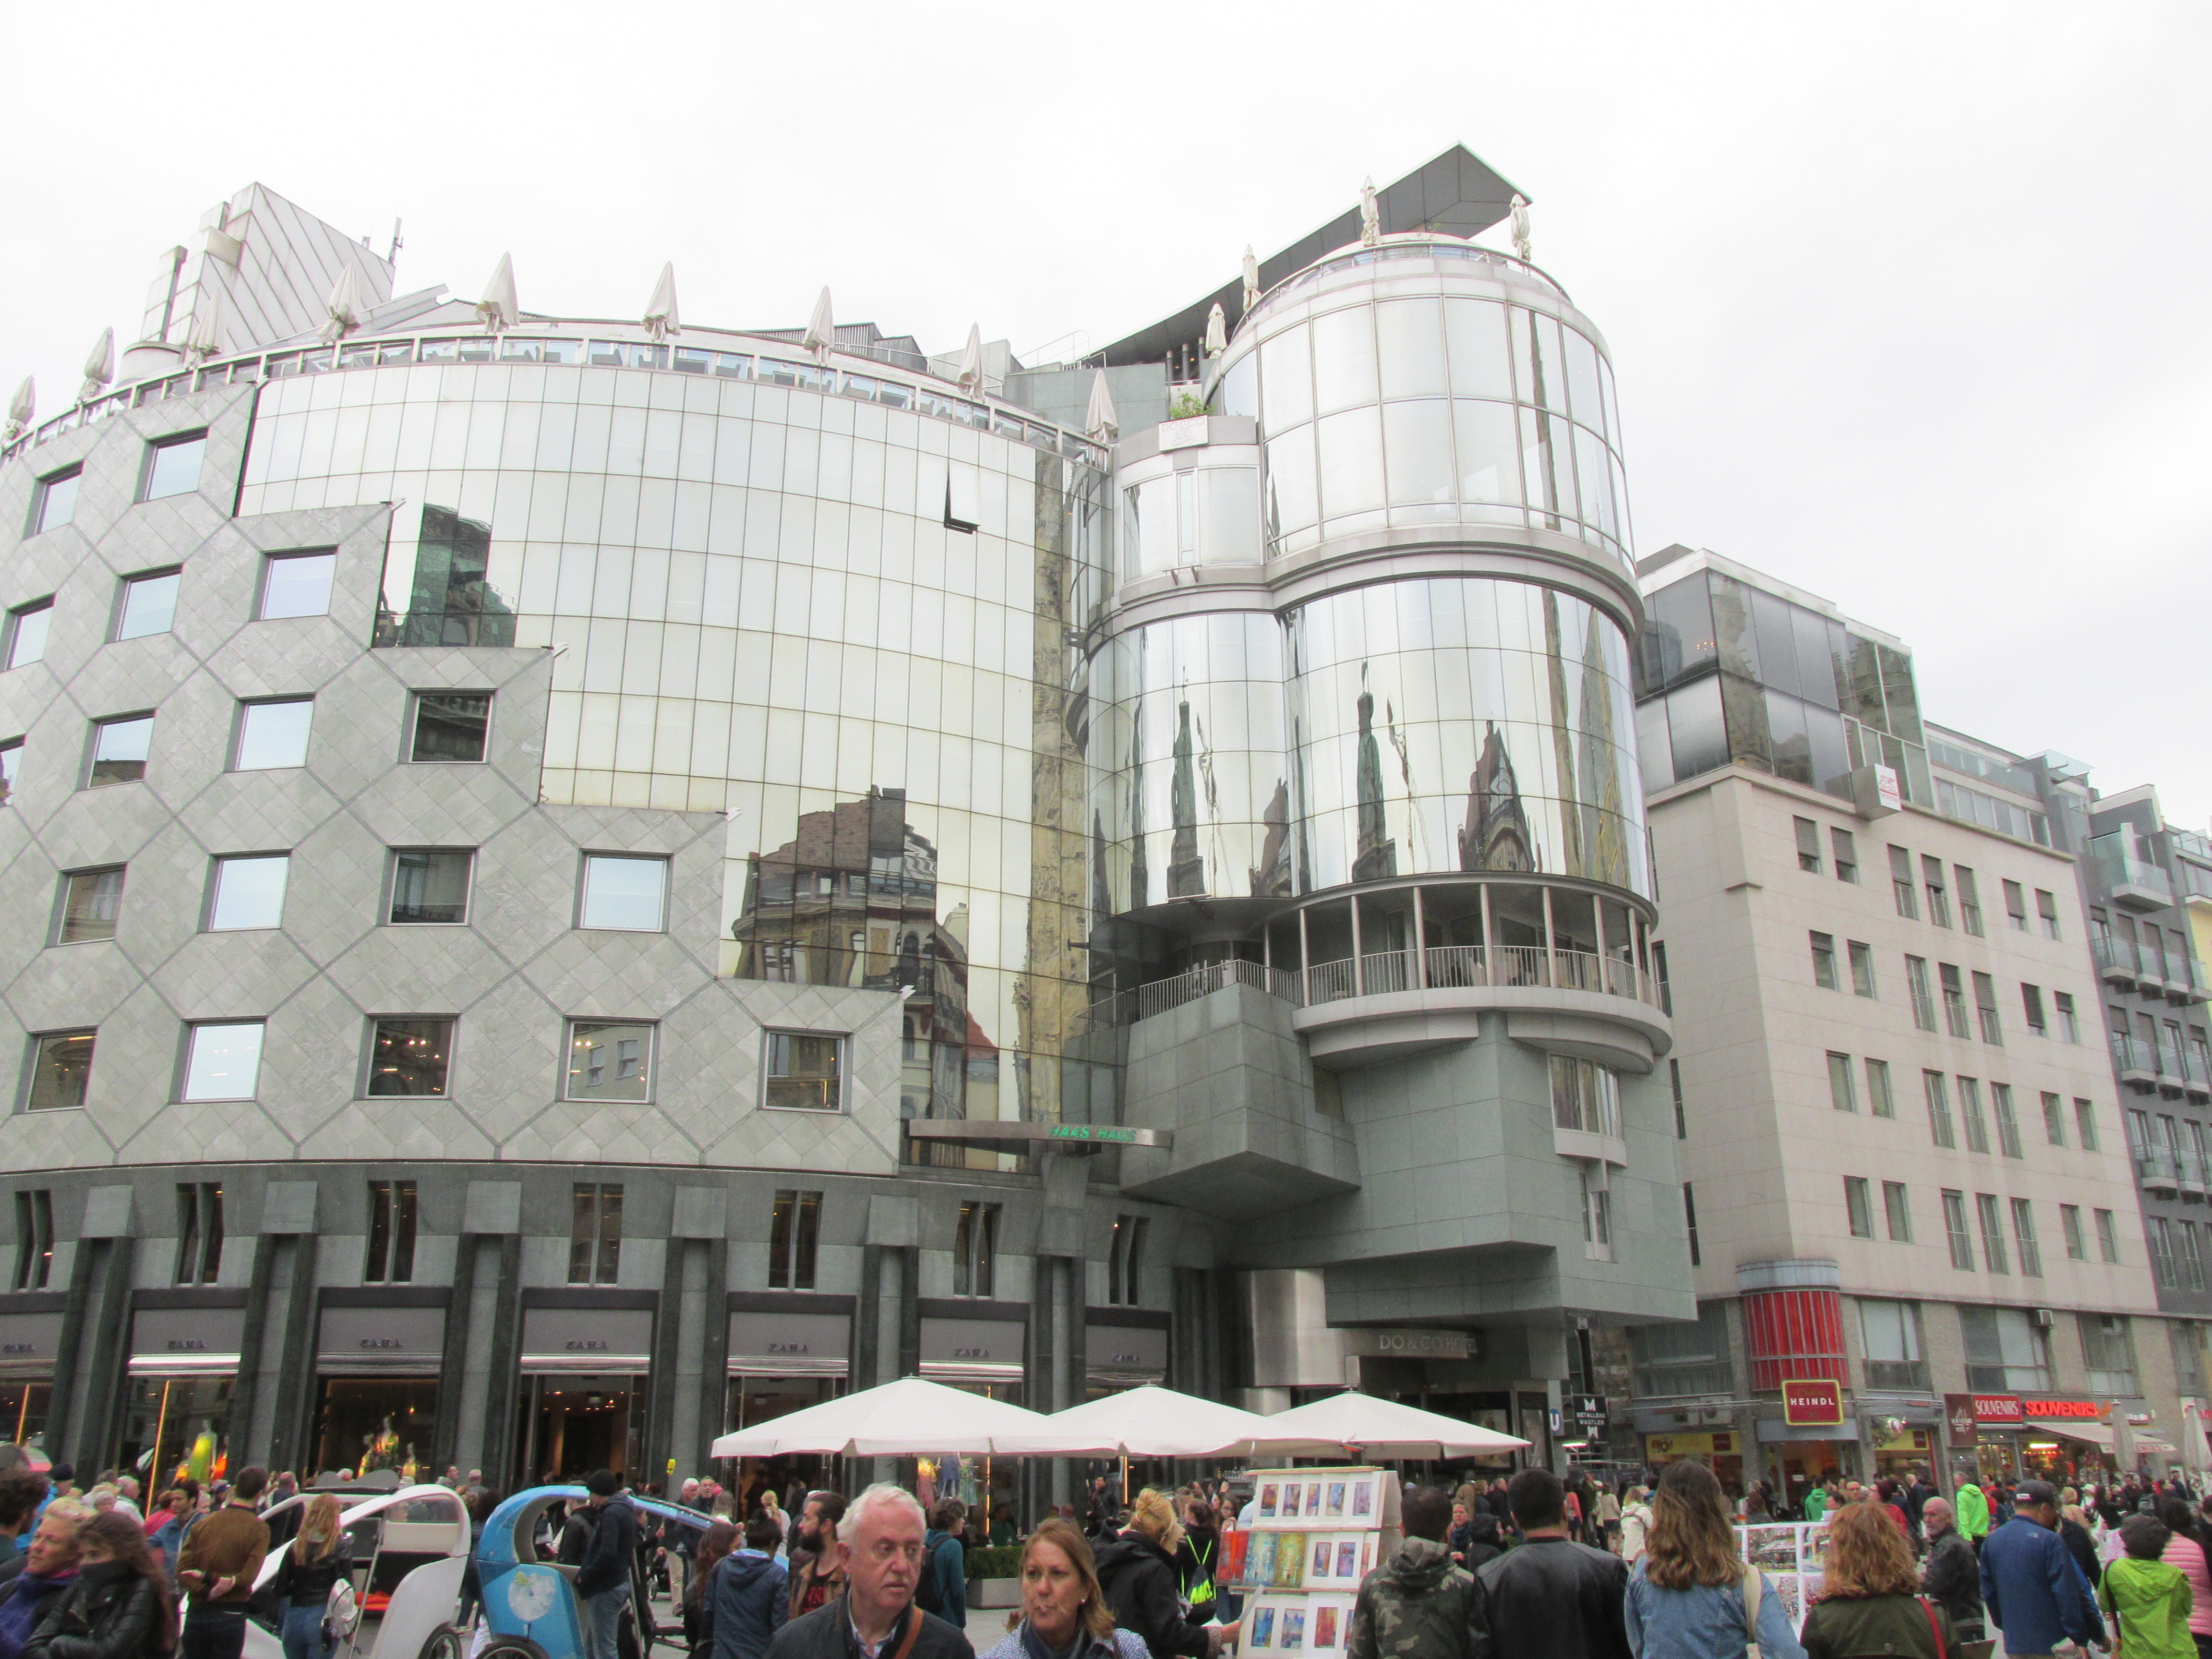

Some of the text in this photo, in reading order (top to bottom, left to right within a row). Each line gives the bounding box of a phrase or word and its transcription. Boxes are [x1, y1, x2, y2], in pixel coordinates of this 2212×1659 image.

[1048, 1126, 1137, 1142] HAAS HAUS
[566, 1340, 608, 1349] ZARA
[769, 1344, 807, 1352] ZARA
[1379, 1334, 1405, 1349] DO
[1420, 1335, 1442, 1349] CO
[954, 1348, 989, 1357] ZARA
[1112, 1353, 1140, 1362] ZARA
[1975, 1400, 2019, 1415] SOUVENIRS
[2025, 1401, 2099, 1417] SOUVENIRS
[1550, 1413, 1560, 1431] U
